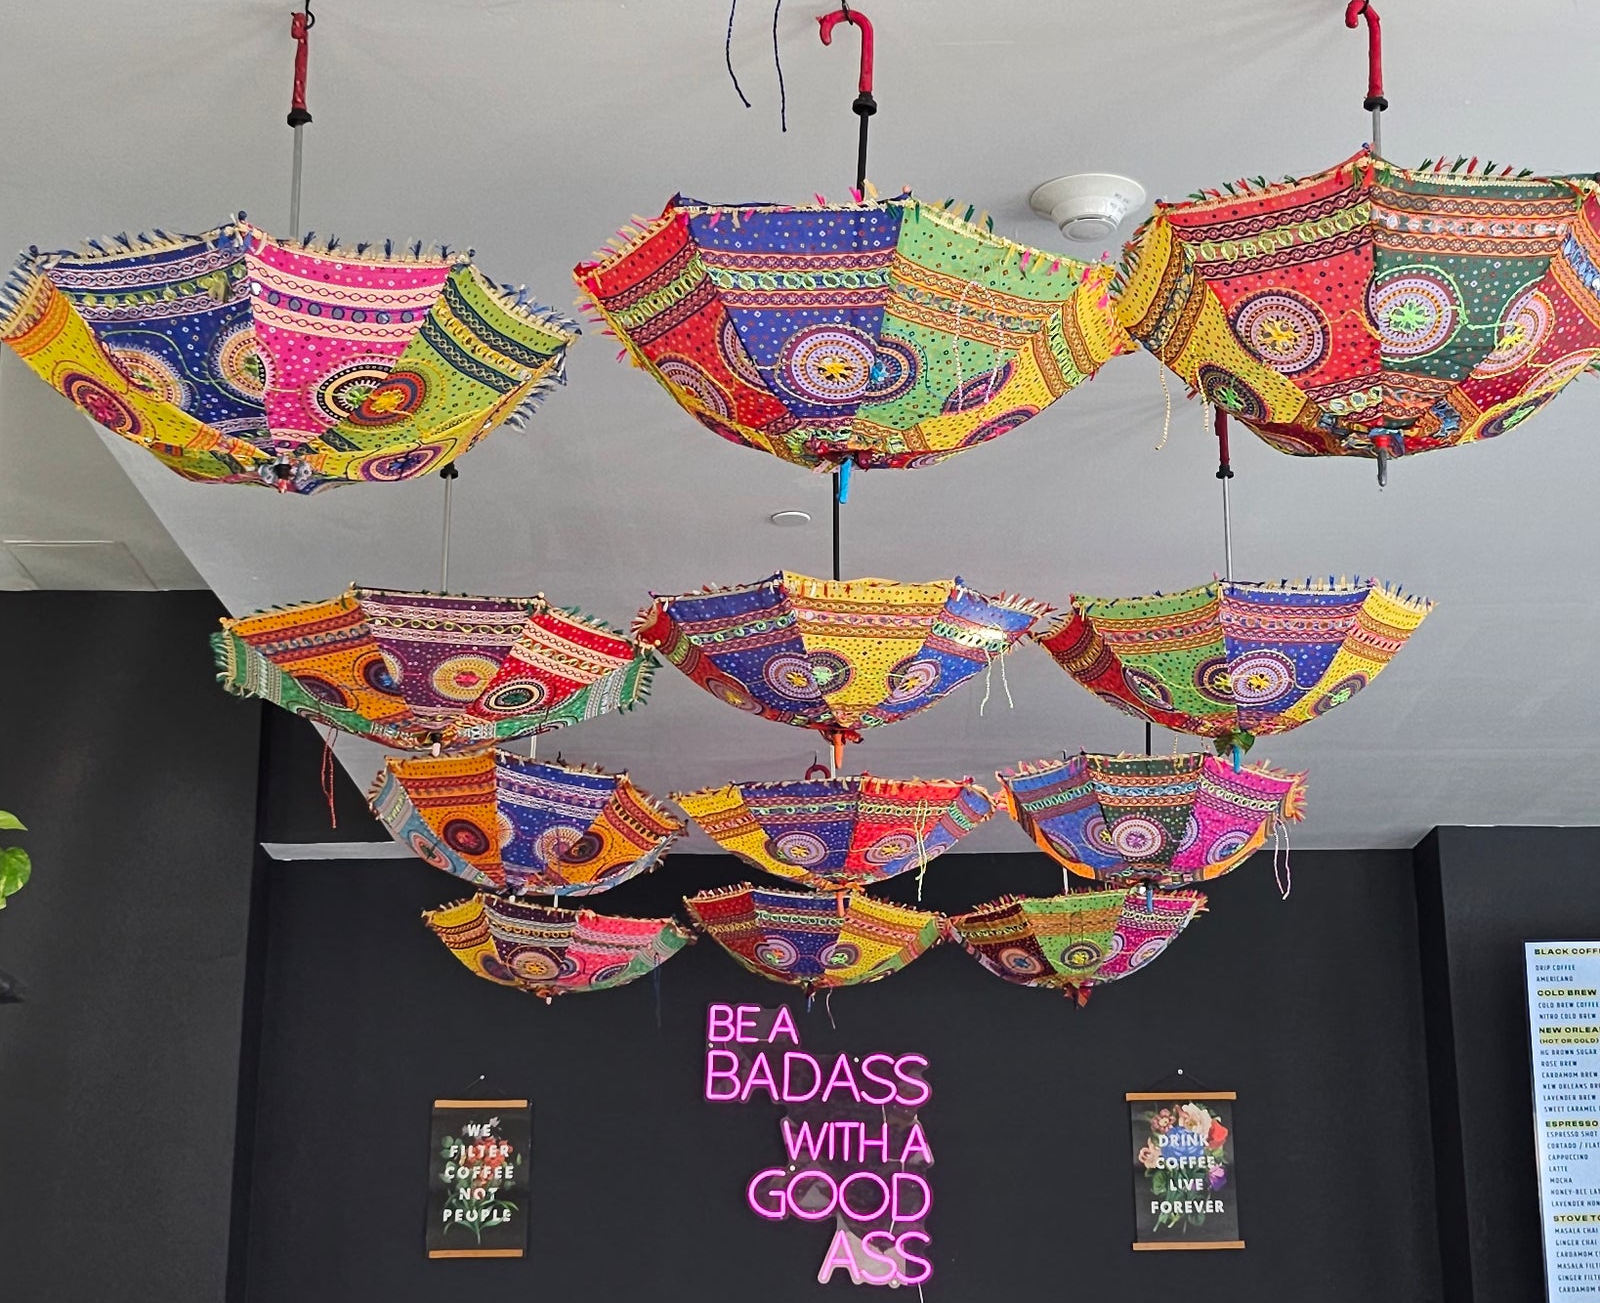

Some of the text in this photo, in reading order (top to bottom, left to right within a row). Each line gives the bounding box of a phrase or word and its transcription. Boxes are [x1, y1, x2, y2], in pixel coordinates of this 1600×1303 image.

[708, 1004, 800, 1045] BE A
[1539, 1026, 1562, 1034] NEW
[706, 1049, 931, 1106] BADASS
[467, 1124, 492, 1138] WE
[783, 1120, 932, 1164] WITH A
[1158, 1133, 1210, 1148] DRINK
[1547, 1142, 1577, 1150] CORTADO
[449, 1144, 510, 1159] FILTER
[444, 1164, 515, 1180] COFFEE
[1169, 1178, 1204, 1192] LIVE
[458, 1187, 499, 1201] NOT
[747, 1169, 932, 1222] GOOD
[1150, 1200, 1225, 1214] FOREVER
[442, 1208, 513, 1223] PEOPLE
[820, 1229, 934, 1285] ASS
